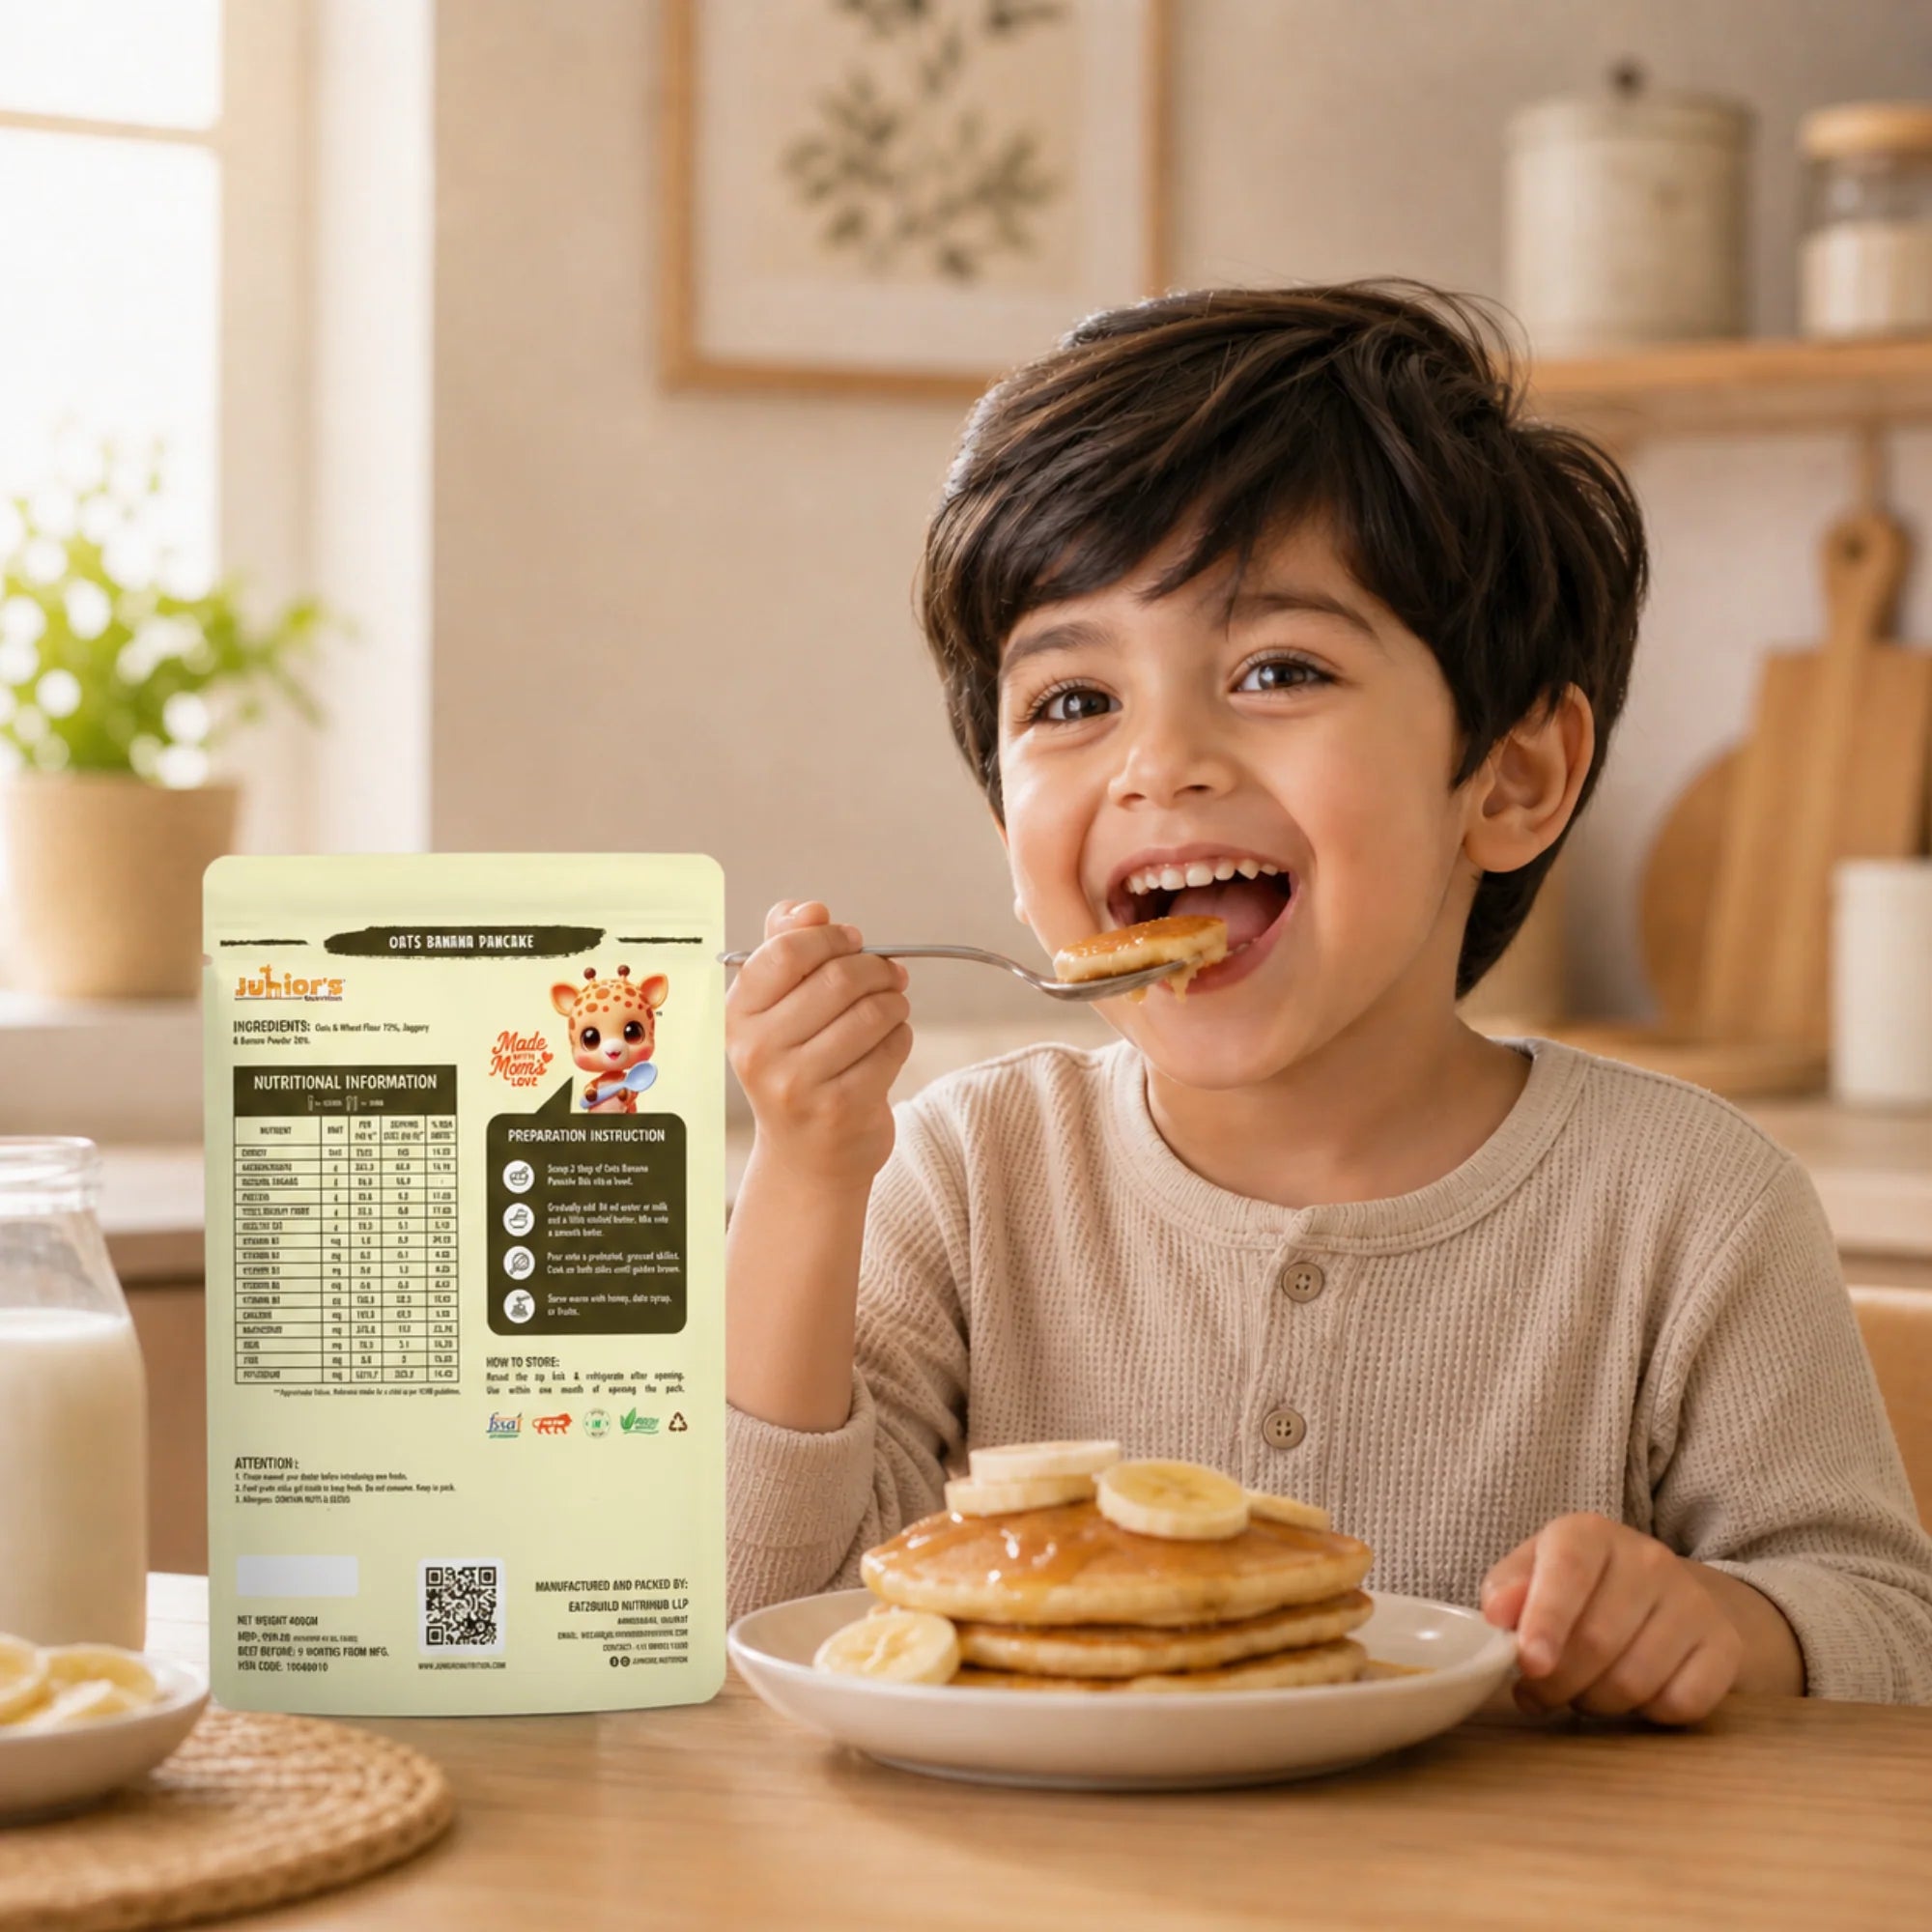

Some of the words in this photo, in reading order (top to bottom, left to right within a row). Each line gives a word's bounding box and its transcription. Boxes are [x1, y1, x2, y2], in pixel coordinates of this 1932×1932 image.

[389, 935, 421, 949] OATS
[427, 935, 473, 948] BANANA
[479, 935, 533, 948] PANCAKE
[234, 1020, 310, 1033] INGREDIENTS:
[492, 1030, 548, 1054] Made
[254, 1075, 341, 1090] NUTRITIONAL
[346, 1074, 437, 1089] INFORMATION
[511, 1077, 537, 1087] LOVE
[508, 1129, 586, 1142] PREPARATION
[591, 1129, 665, 1141] INSTRUCTION
[486, 1357, 509, 1368] HOW
[511, 1357, 523, 1368] TO
[526, 1356, 559, 1367] STORE:
[516, 1373, 527, 1381] the
[235, 1457, 293, 1469] ATTENTION
[535, 1580, 610, 1592] MANUFACTURED
[612, 1580, 633, 1590] AND
[635, 1579, 670, 1590] PACKED
[672, 1599, 689, 1609] LLP
[238, 1615, 252, 1625] NET
